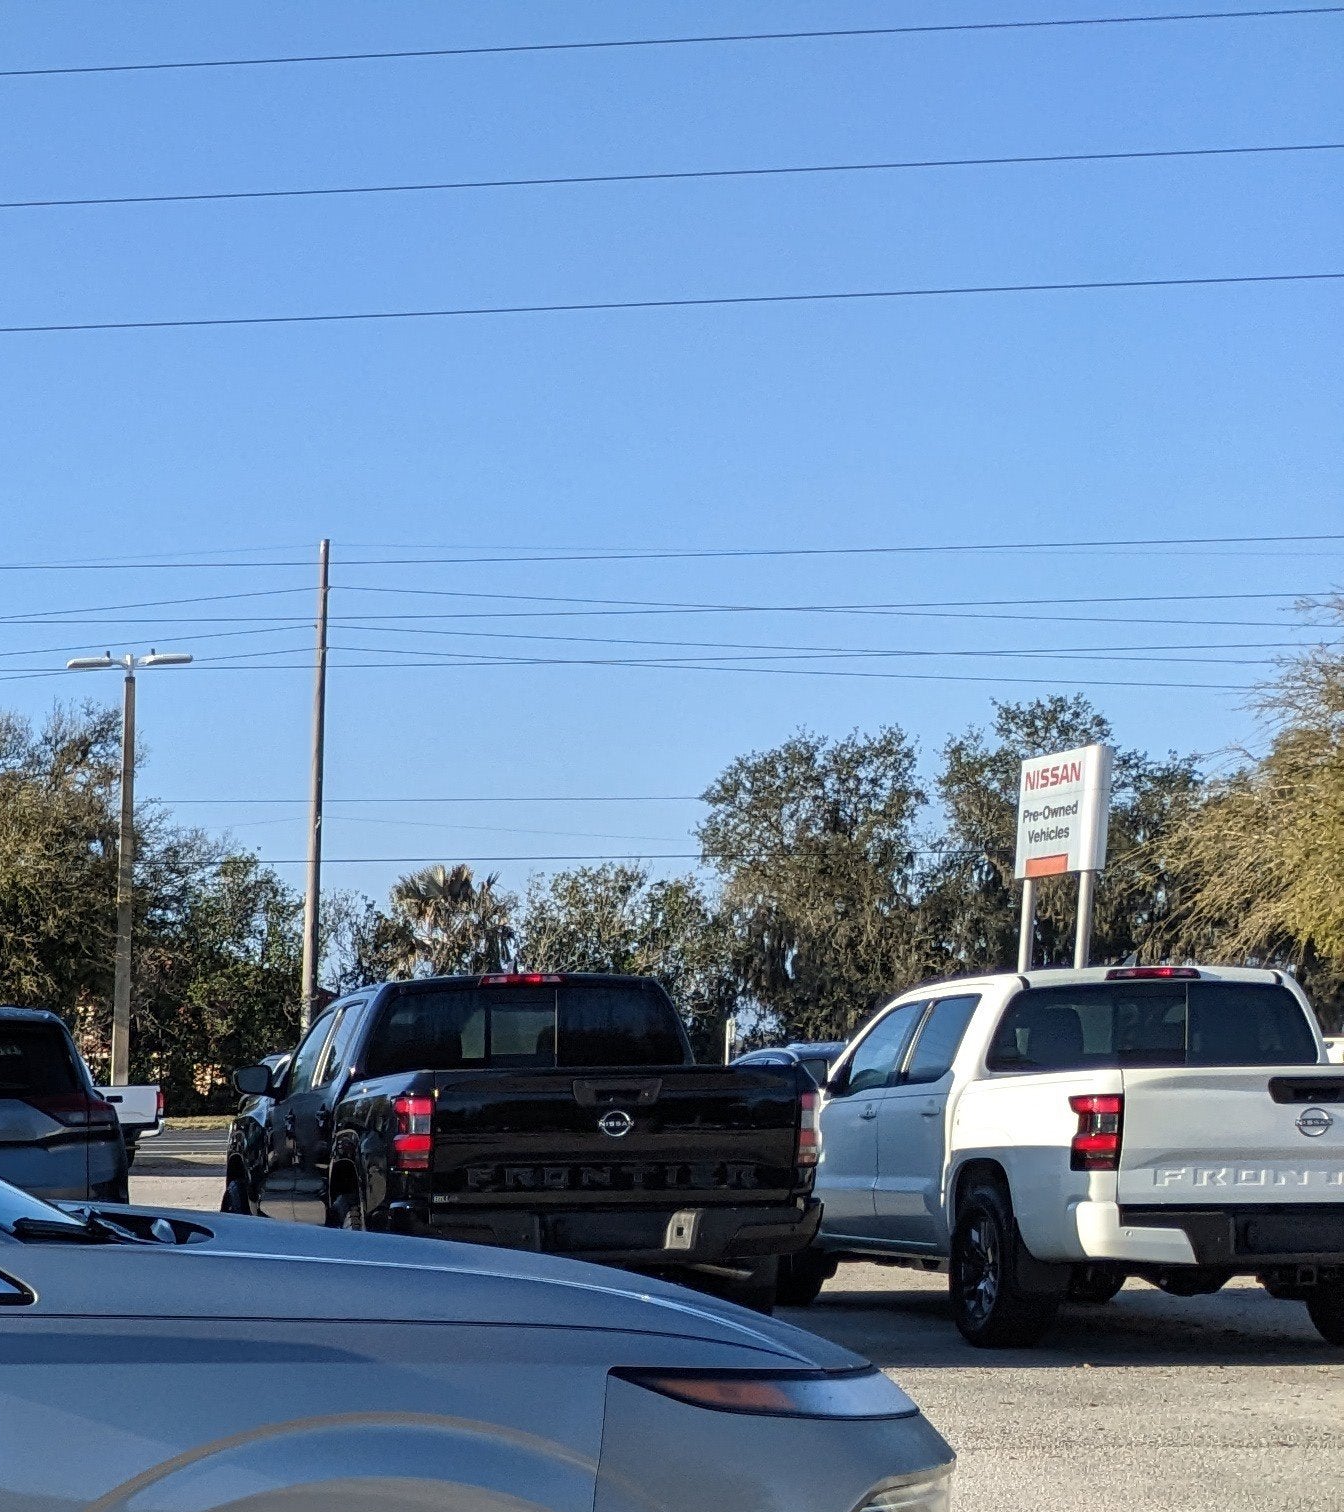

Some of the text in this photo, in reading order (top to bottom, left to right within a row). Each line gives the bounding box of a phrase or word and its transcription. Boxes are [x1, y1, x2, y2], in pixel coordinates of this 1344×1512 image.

[1024, 761, 1081, 791] NISSAN
[1022, 799, 1079, 824] Pre-Owned
[1027, 825, 1070, 845] Vehicles
[465, 1165, 758, 1188] FRONTIER
